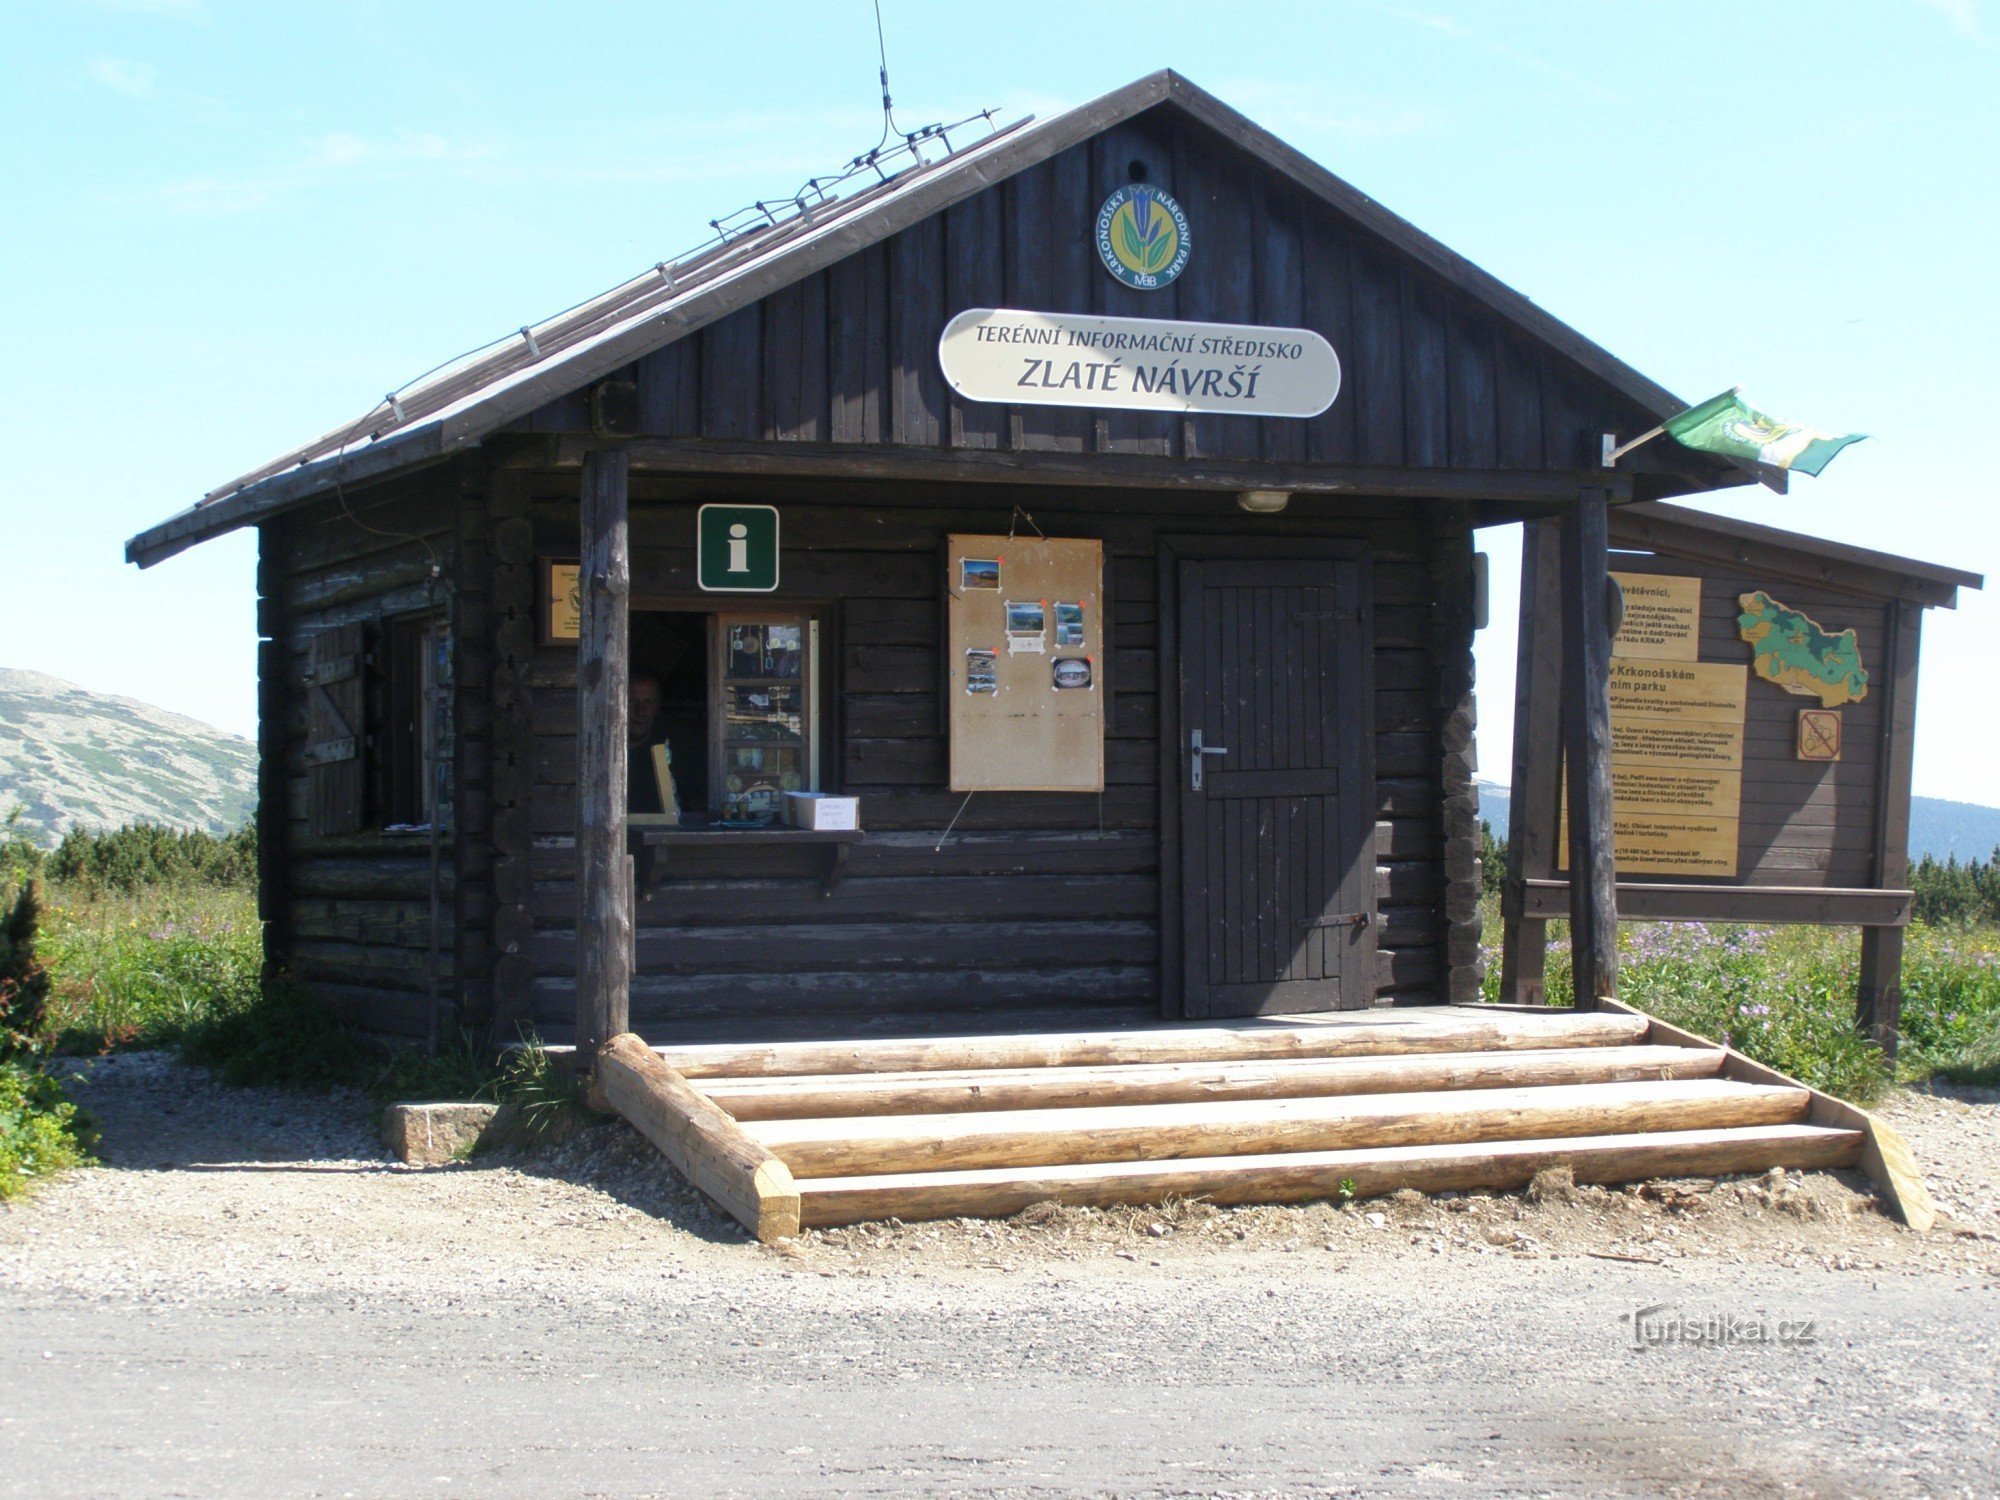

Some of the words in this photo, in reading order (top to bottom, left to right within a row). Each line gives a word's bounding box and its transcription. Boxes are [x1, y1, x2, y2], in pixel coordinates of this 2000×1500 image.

[1100, 189, 1124, 275] KRKONOŠSKÝ
[1157, 192, 1191, 247] NÁRODNÍ
[1166, 249, 1188, 278] PARK
[976, 324, 1063, 345] TERÉNNÍ
[1067, 329, 1197, 354] INFORMAČNÍ
[1199, 336, 1303, 360] STŘEDISKO
[1017, 356, 1122, 392] ZLATÉ
[1131, 359, 1261, 399] NÁVRŠÍ
[1617, 665, 1695, 681] Krkonošském
[1634, 681, 1666, 693] parku
